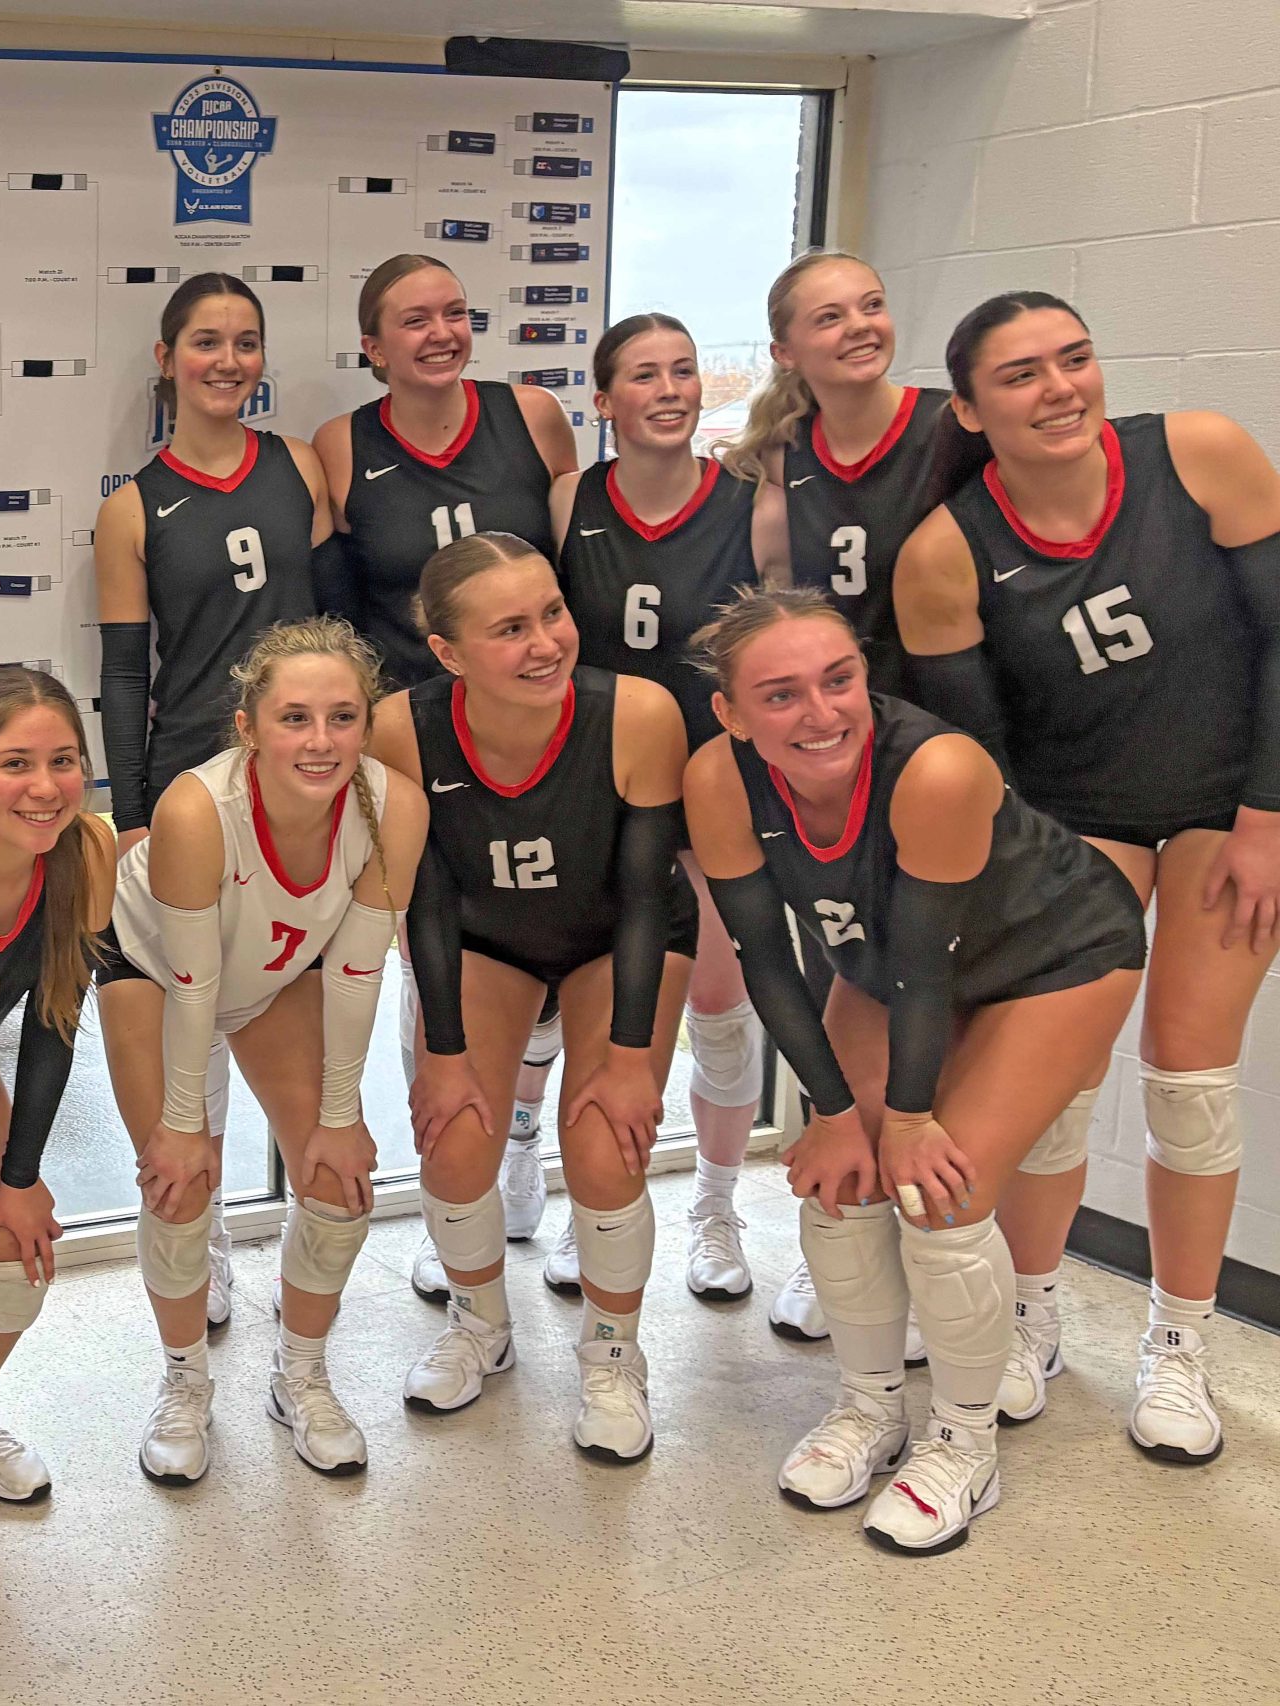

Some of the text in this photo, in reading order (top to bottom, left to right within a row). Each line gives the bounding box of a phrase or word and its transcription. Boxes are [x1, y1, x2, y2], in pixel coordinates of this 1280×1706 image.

[204, 83, 248, 106] DIVISION
[171, 119, 259, 140] CHAMPIONSHIP
[182, 159, 249, 184] VOLLEYBALL
[431, 503, 476, 550] 11
[226, 526, 267, 592] 9
[830, 525, 867, 596] 3
[624, 584, 661, 650] 6
[1063, 584, 1154, 675] 15
[489, 836, 558, 889] 12
[263, 920, 308, 972] 7
[815, 898, 865, 947] 2
